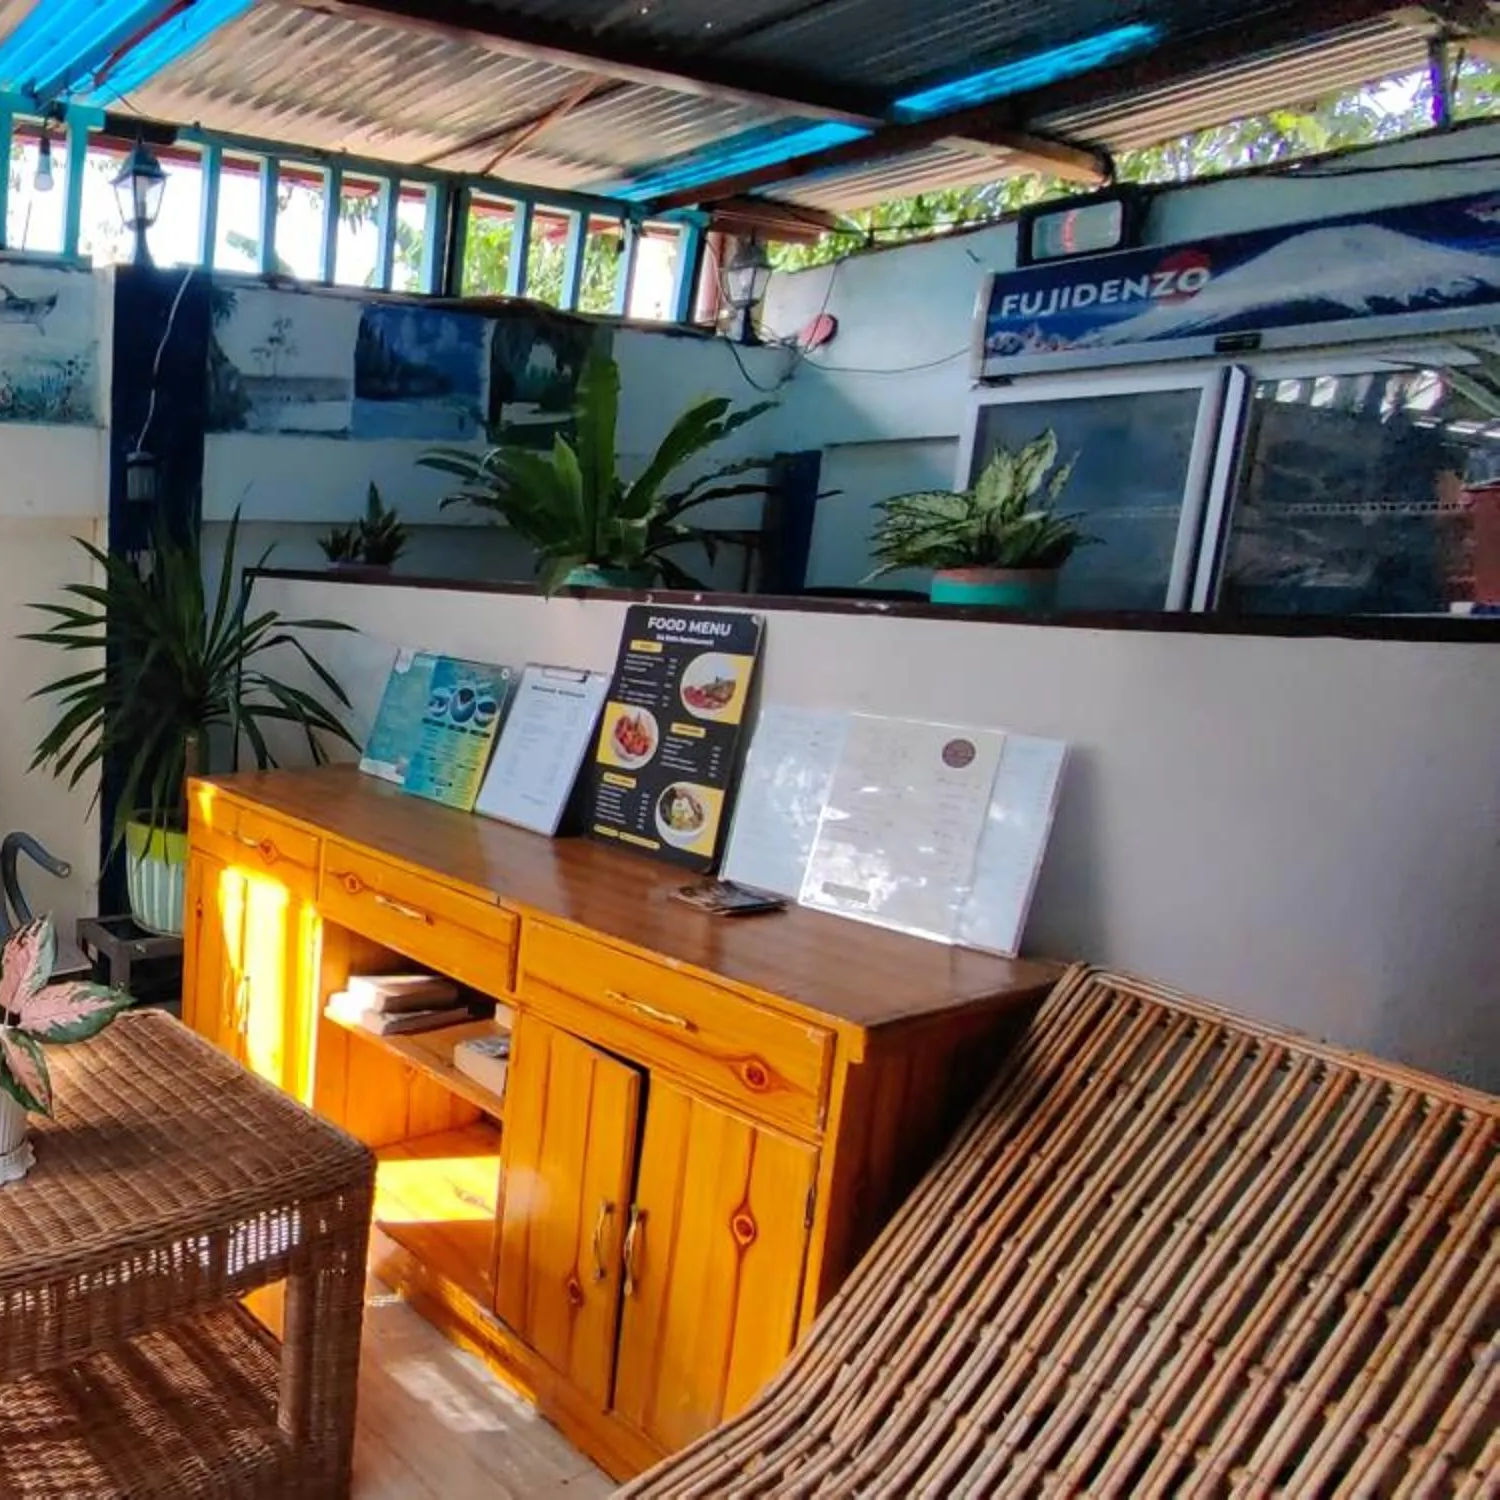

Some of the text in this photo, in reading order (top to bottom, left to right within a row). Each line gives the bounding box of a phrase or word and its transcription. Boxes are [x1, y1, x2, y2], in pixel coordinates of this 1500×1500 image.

[1002, 266, 1211, 319] FUJIDENZO
[647, 616, 732, 637] FOOD MENU
